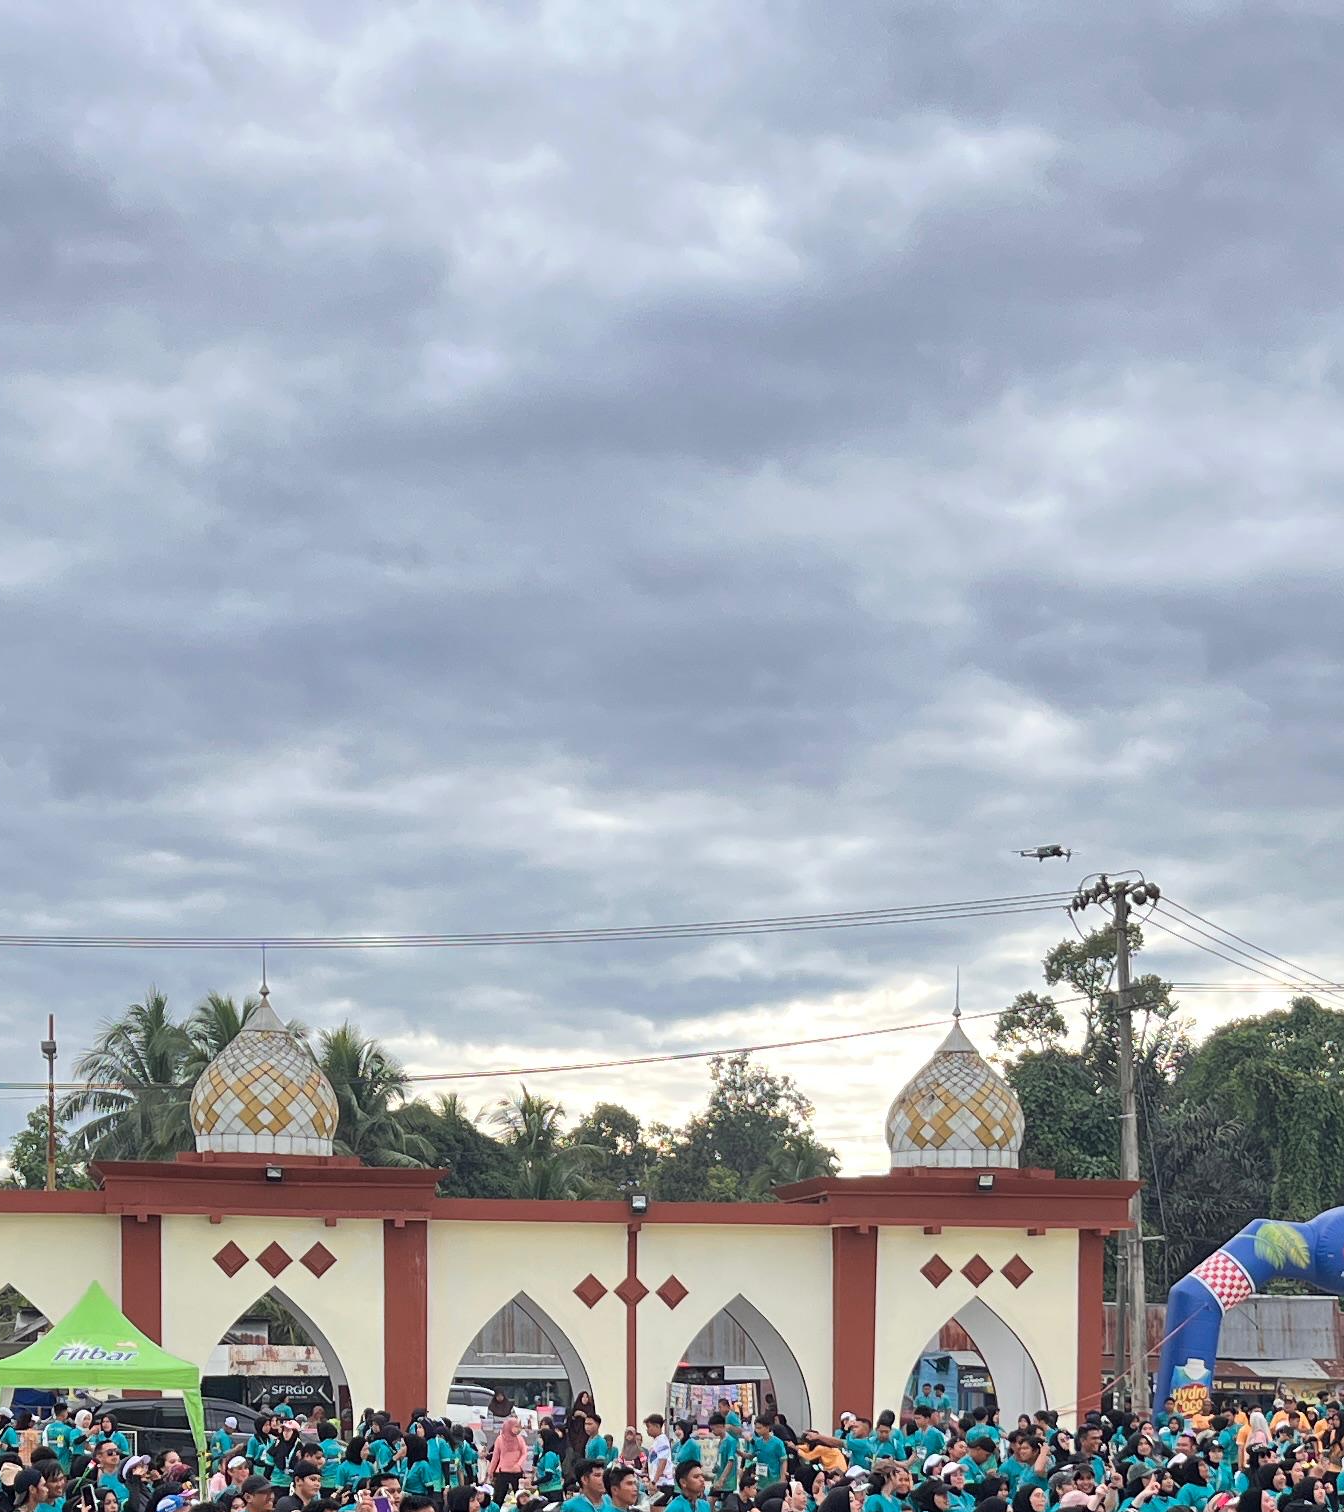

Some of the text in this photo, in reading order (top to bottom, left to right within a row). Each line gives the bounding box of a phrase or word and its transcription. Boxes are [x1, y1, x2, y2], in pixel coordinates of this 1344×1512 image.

[54, 1346, 138, 1361] Fitbar
[1172, 1385, 1208, 1400] Hydro
[1175, 1399, 1203, 1416] Coco
